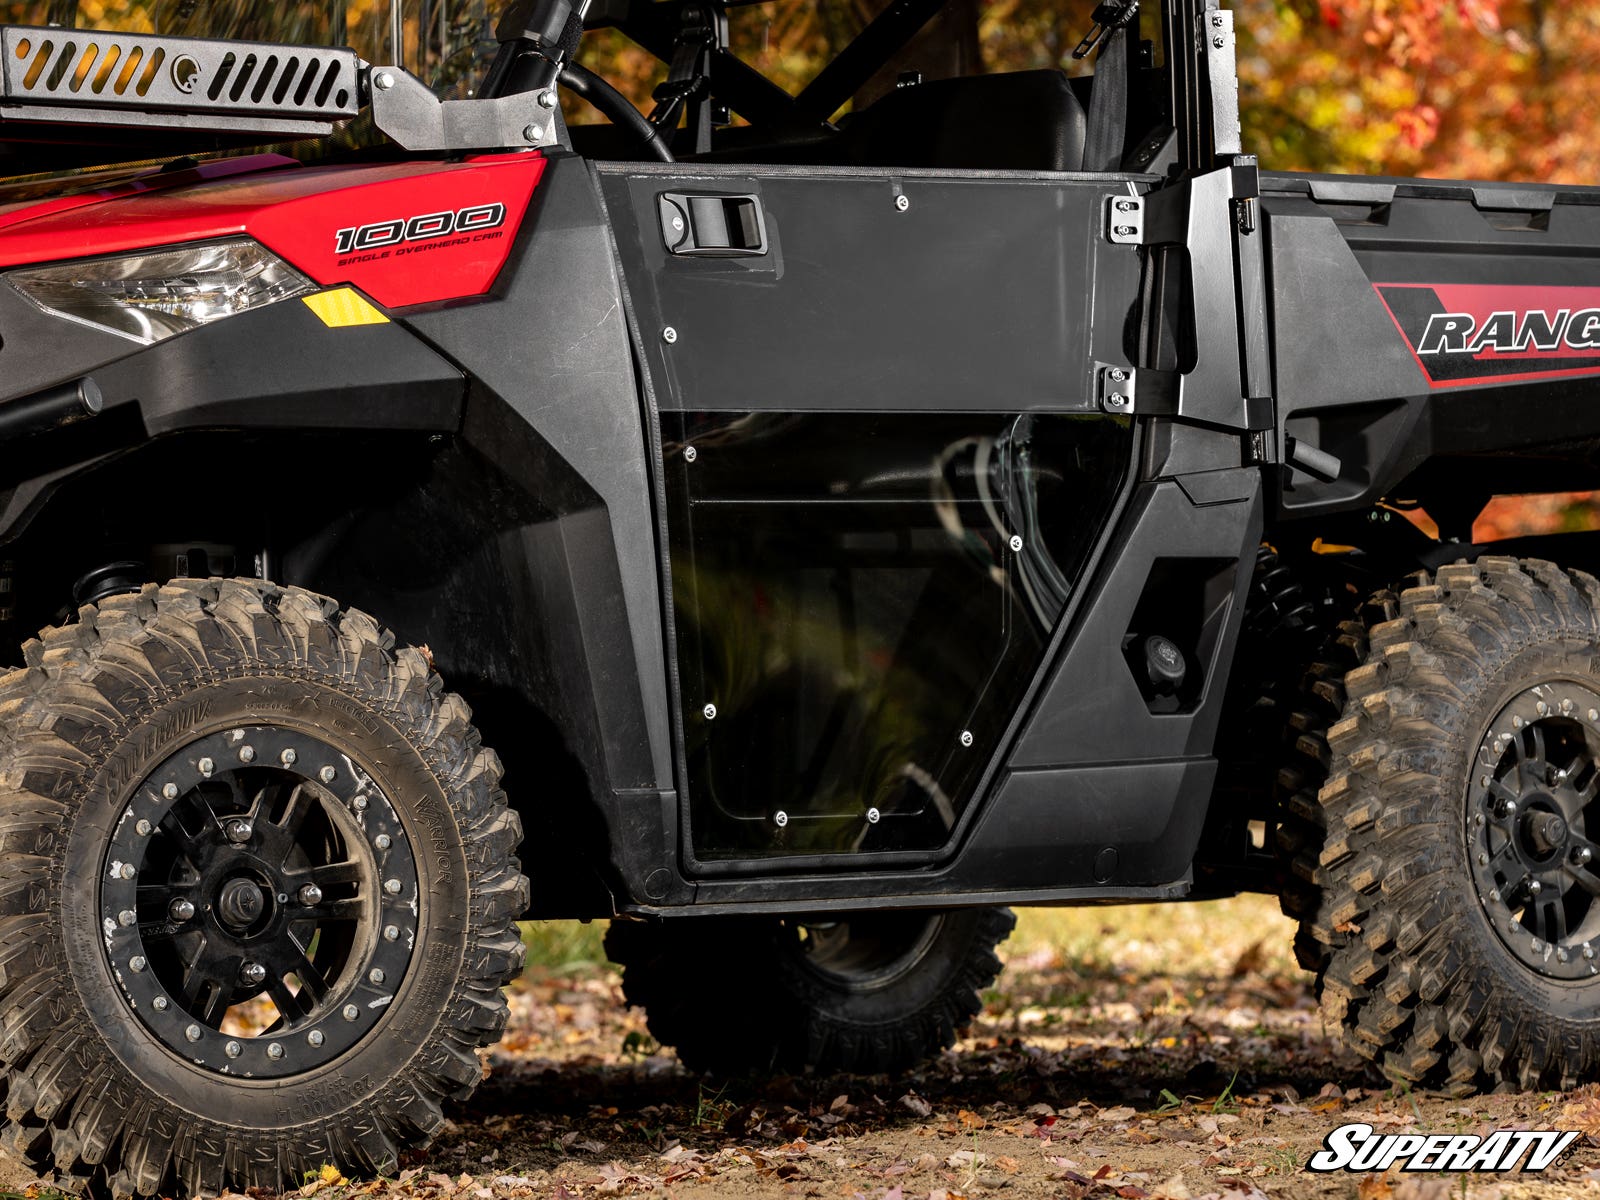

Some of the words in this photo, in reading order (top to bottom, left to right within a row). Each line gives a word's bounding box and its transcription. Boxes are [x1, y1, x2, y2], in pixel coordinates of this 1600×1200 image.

[334, 203, 507, 255] 1000
[337, 250, 391, 267] SINGLE
[395, 237, 471, 256] OVERHEAD
[473, 231, 504, 242] CAM
[413, 794, 452, 885] WARRIOR
